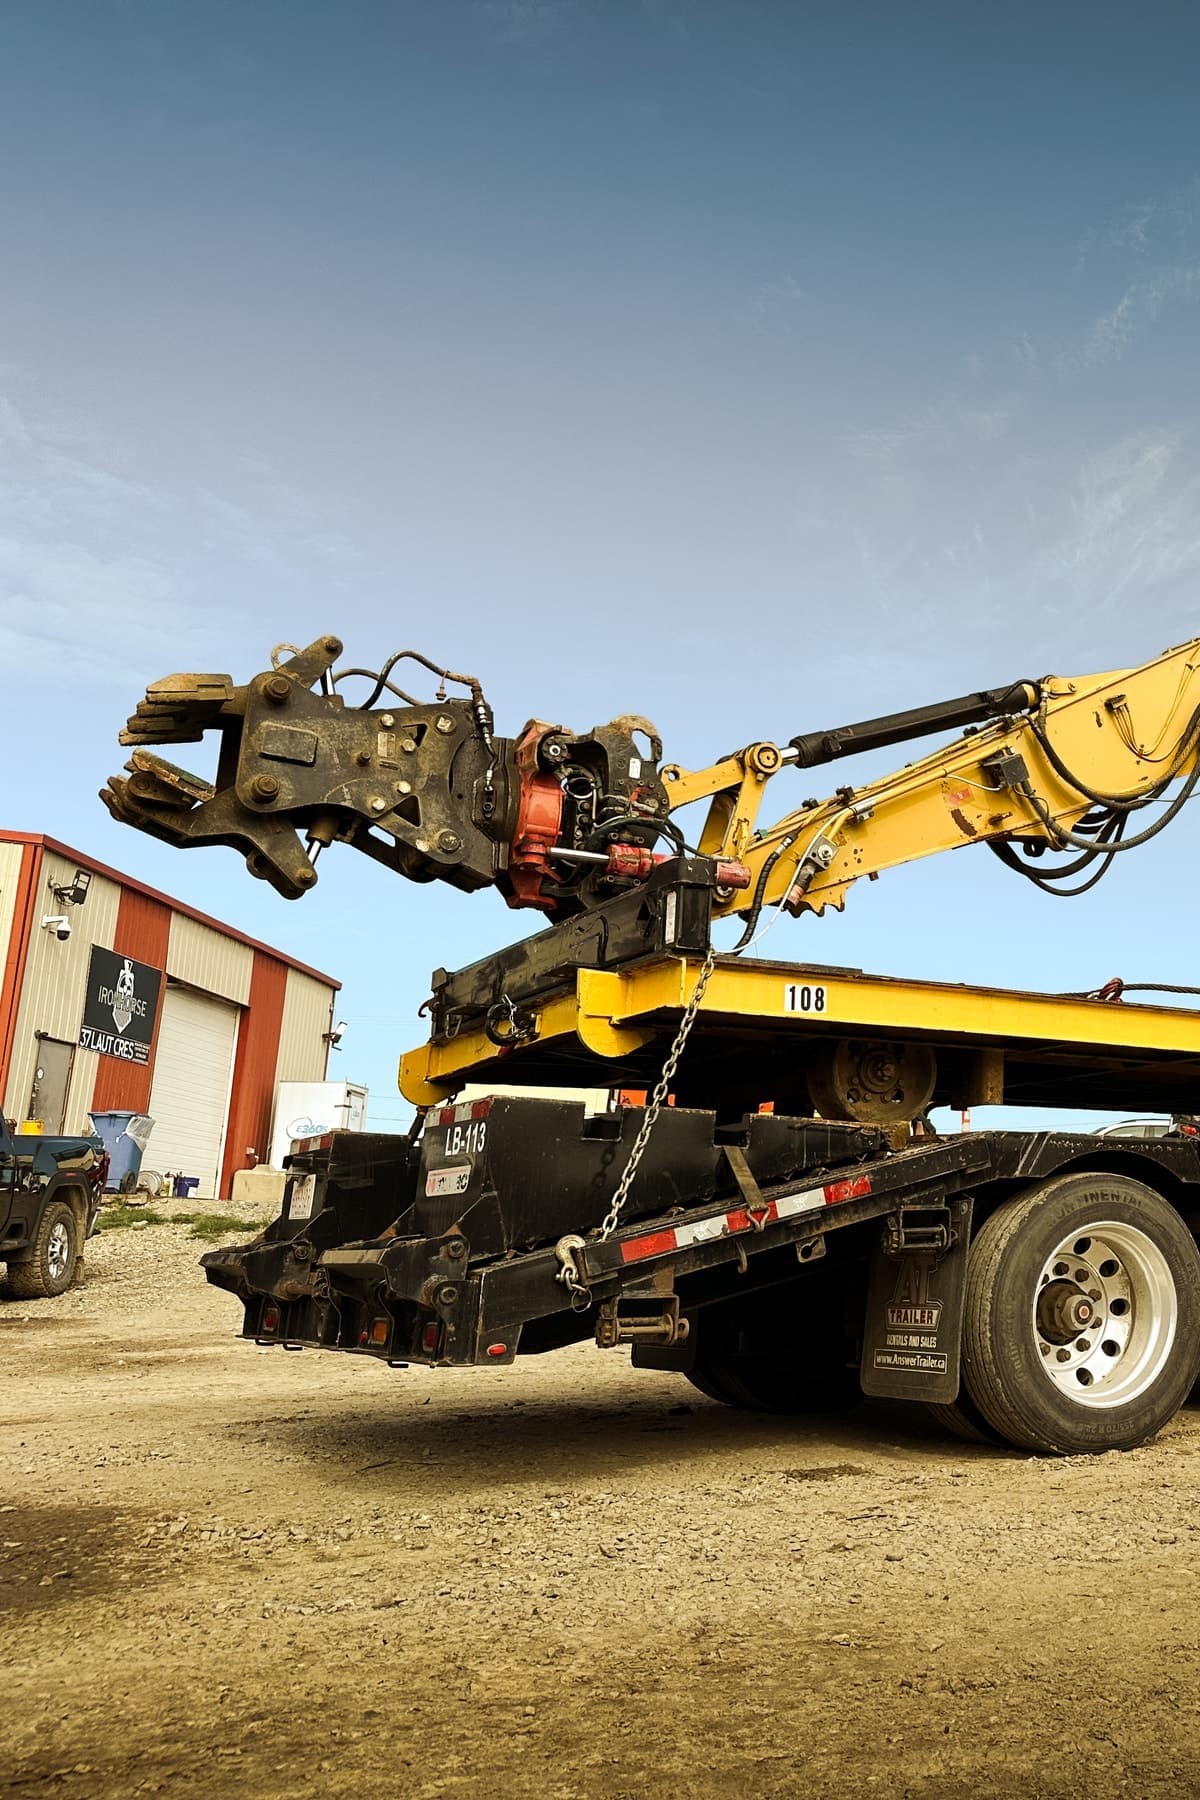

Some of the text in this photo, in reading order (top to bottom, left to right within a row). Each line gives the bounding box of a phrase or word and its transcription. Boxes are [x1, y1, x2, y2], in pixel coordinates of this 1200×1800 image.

[789, 985, 825, 1012] 108
[79, 1028, 91, 1048] 37
[91, 1031, 115, 1053] LAUT
[113, 1038, 135, 1060] CRES
[445, 1121, 486, 1156] LB-113
[890, 1309, 934, 1325] TRAILER
[908, 1335, 920, 1347] AND
[920, 1336, 937, 1348] SALES
[876, 1353, 945, 1369] www.AnswerTrailer.ca
